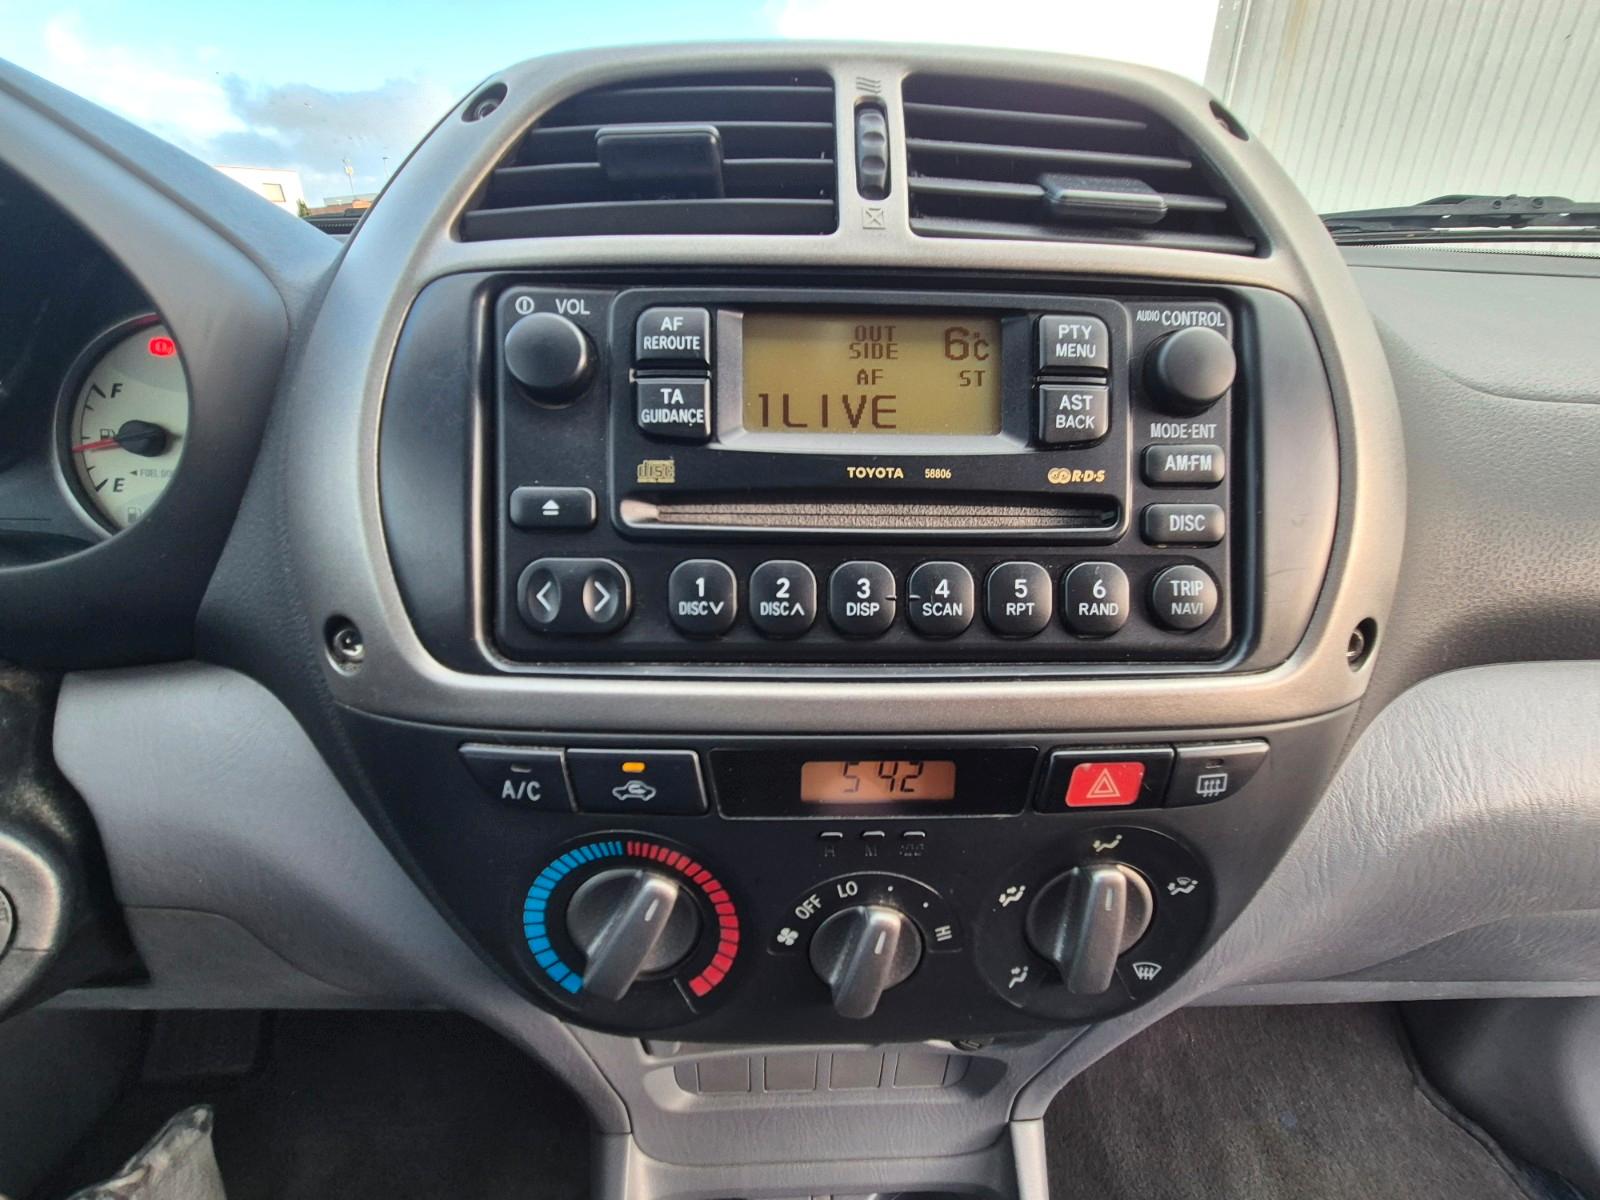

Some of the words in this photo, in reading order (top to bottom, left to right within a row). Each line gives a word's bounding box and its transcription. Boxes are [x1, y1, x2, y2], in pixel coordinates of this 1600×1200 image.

[555, 298, 590, 315] VOL
[661, 317, 684, 331] AF
[1136, 310, 1160, 321] AUDIO
[1162, 311, 1225, 327] CONTROL
[855, 325, 896, 342] OUT
[1058, 324, 1093, 339] PTY
[643, 336, 700, 350] REROUTE
[850, 343, 898, 359] SIDE
[1056, 343, 1096, 358] MENU
[857, 369, 883, 385] AF
[959, 370, 986, 387] ST
[110, 383, 123, 398] F
[660, 388, 684, 404] TA
[1059, 395, 1093, 410] AST
[641, 408, 704, 423] GUIDANCE
[1056, 415, 1095, 429] BACK
[847, 467, 904, 479] TOYOTA
[925, 468, 952, 479] 58806
[113, 478, 125, 493] E
[1169, 514, 1206, 531] DISC
[695, 577, 705, 597] 1
[776, 577, 790, 598] 2
[857, 578, 871, 599] 3
[934, 579, 950, 598] 4
[1014, 579, 1028, 598] 5
[1092, 579, 1106, 599] 6
[1170, 580, 1204, 597] TRIP
[678, 601, 708, 616] DISC
[760, 603, 790, 616] DISC
[846, 603, 880, 617] DISP
[922, 603, 963, 617] SCAN
[1006, 602, 1035, 616] RPT
[1078, 603, 1119, 616] RAND
[1171, 602, 1204, 615] NAVI
[501, 780, 541, 801] A/C
[836, 880, 859, 899] LO
[794, 893, 823, 920] OFF
[934, 924, 953, 942] HI
